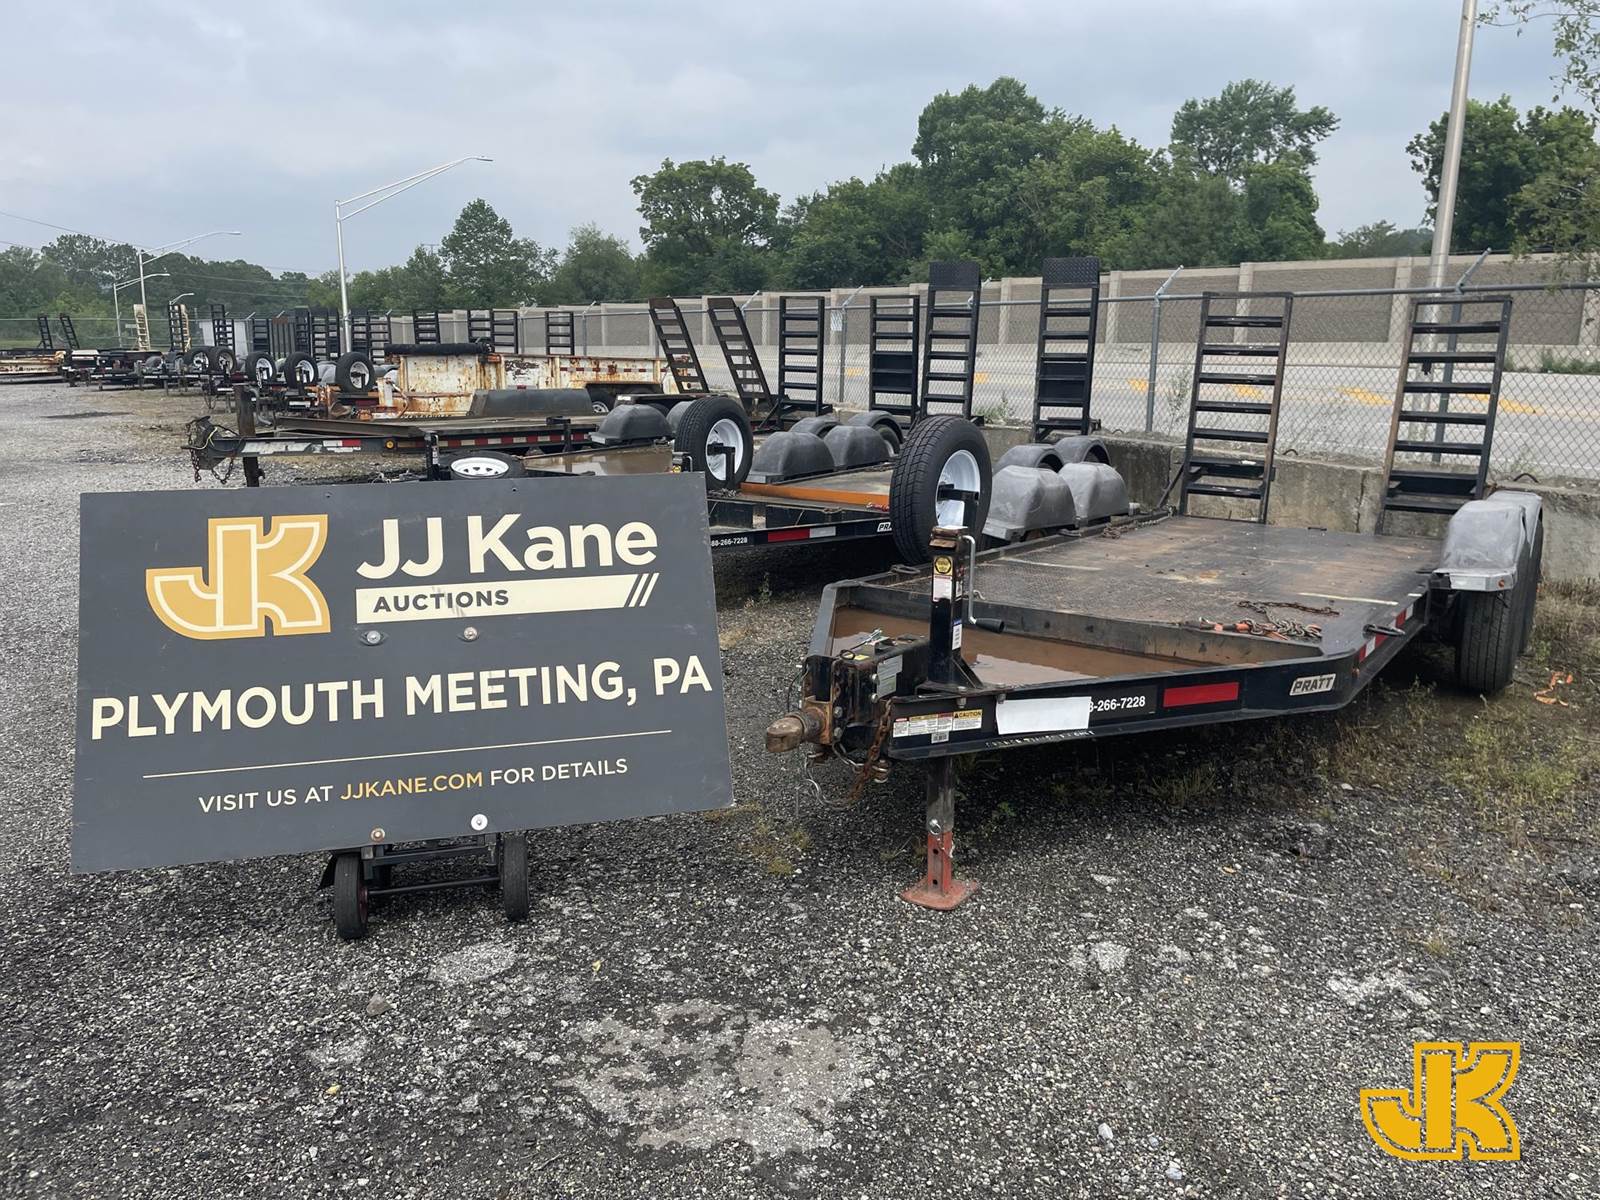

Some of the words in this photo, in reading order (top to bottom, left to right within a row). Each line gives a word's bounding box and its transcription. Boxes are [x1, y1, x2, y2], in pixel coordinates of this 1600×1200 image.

[357, 517, 444, 579] JJ
[468, 514, 658, 574] Kane
[146, 514, 331, 640] JK
[373, 589, 509, 613] AUCTIONS
[92, 680, 384, 740] PLYMOUTH
[406, 661, 637, 716] MEETING,
[654, 655, 712, 696] PA
[1293, 676, 1333, 694] PRATT
[198, 792, 259, 813] VISIT
[266, 789, 297, 807] US
[304, 786, 334, 804] AT
[341, 772, 483, 801] JJKANE.COM
[491, 767, 535, 786] FOR
[542, 758, 628, 781] DETAILS
